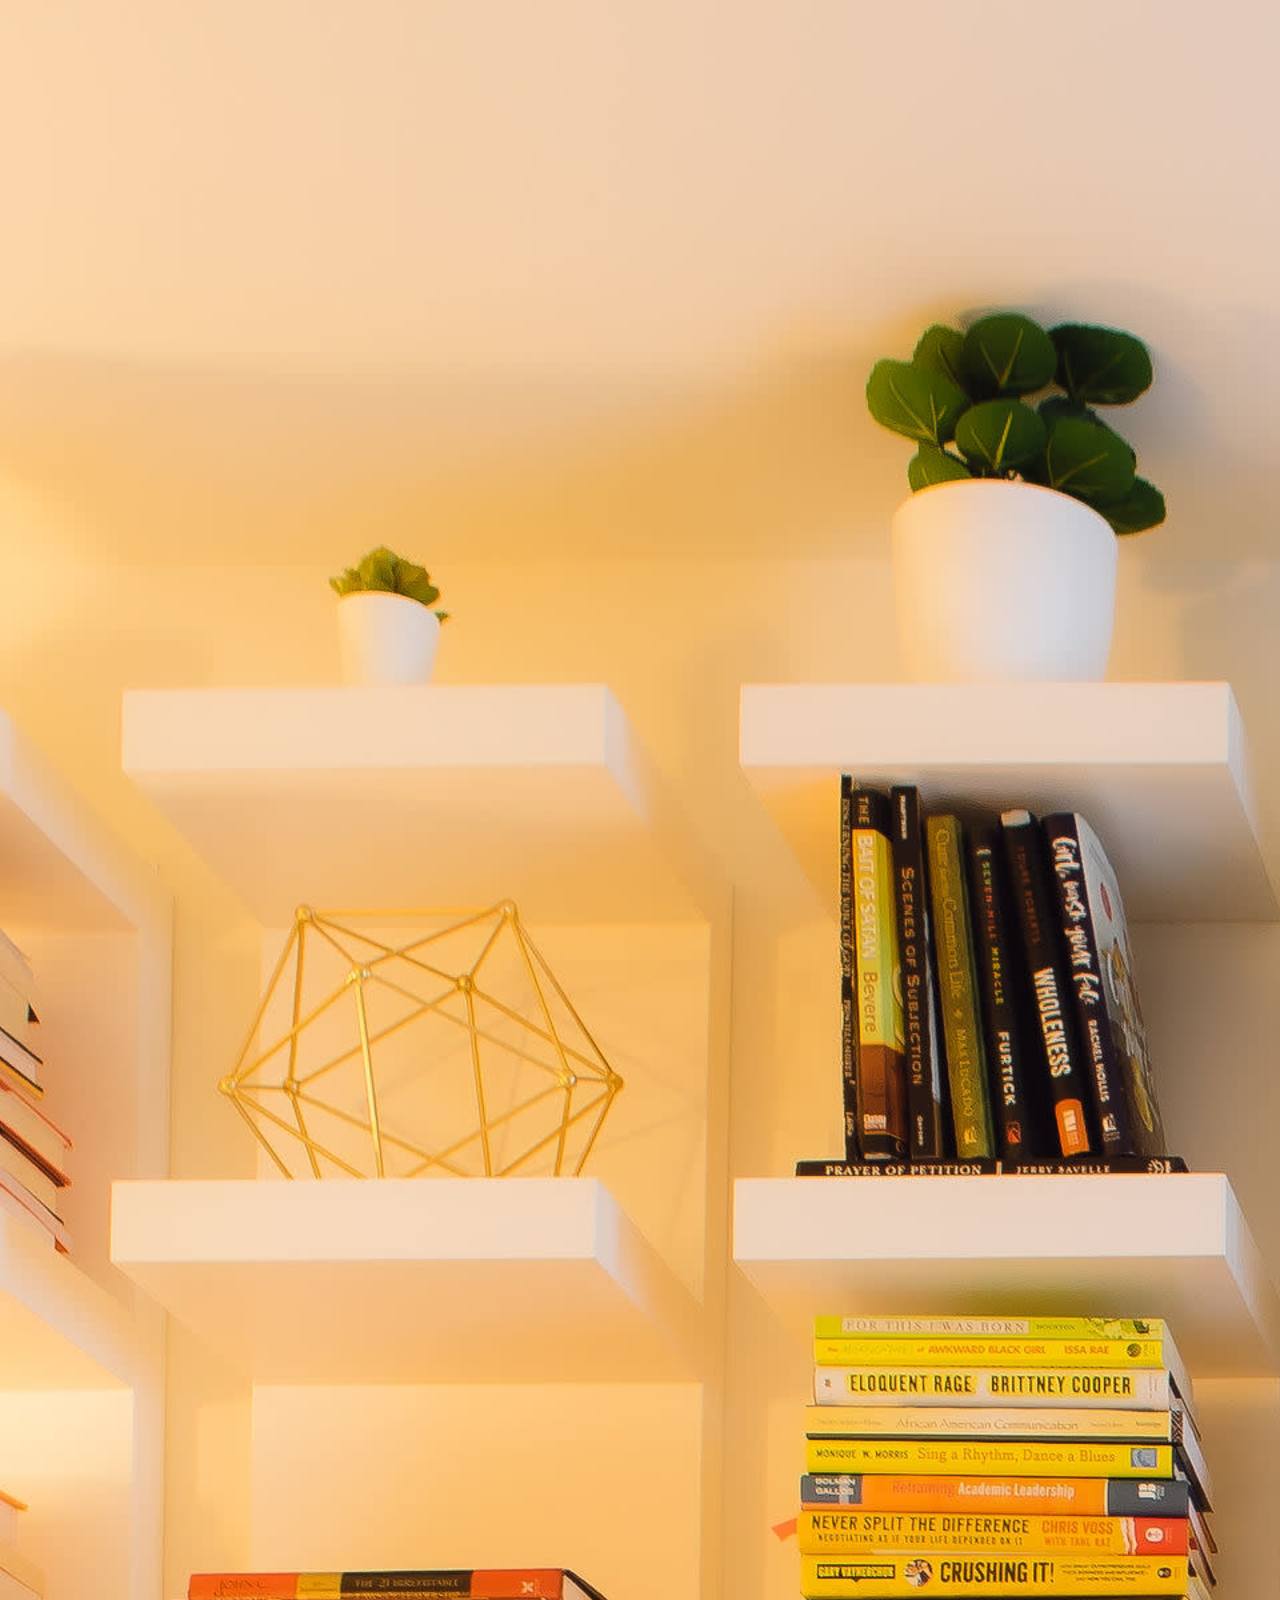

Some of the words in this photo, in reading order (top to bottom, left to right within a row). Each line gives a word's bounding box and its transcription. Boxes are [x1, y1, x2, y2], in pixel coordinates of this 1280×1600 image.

[1034, 968, 1071, 1078] WHOLENESS
[826, 1165, 882, 1175] PRAYER
[886, 1165, 906, 1175] OF
[910, 1164, 982, 1175] PETITION
[850, 1375, 929, 1392] ELOQUENT
[934, 1376, 972, 1392] RAGE
[991, 1376, 1067, 1393] BRITTNEY
[1072, 1377, 1130, 1394] COOPER
[811, 1516, 858, 1530] NEVER
[863, 1517, 902, 1531] SPLIT
[910, 1518, 935, 1532] THE
[942, 1519, 1029, 1533] DIFFERENCE
[940, 1562, 1028, 1583] CRUSHING
[1033, 1562, 1055, 1583] IT!
